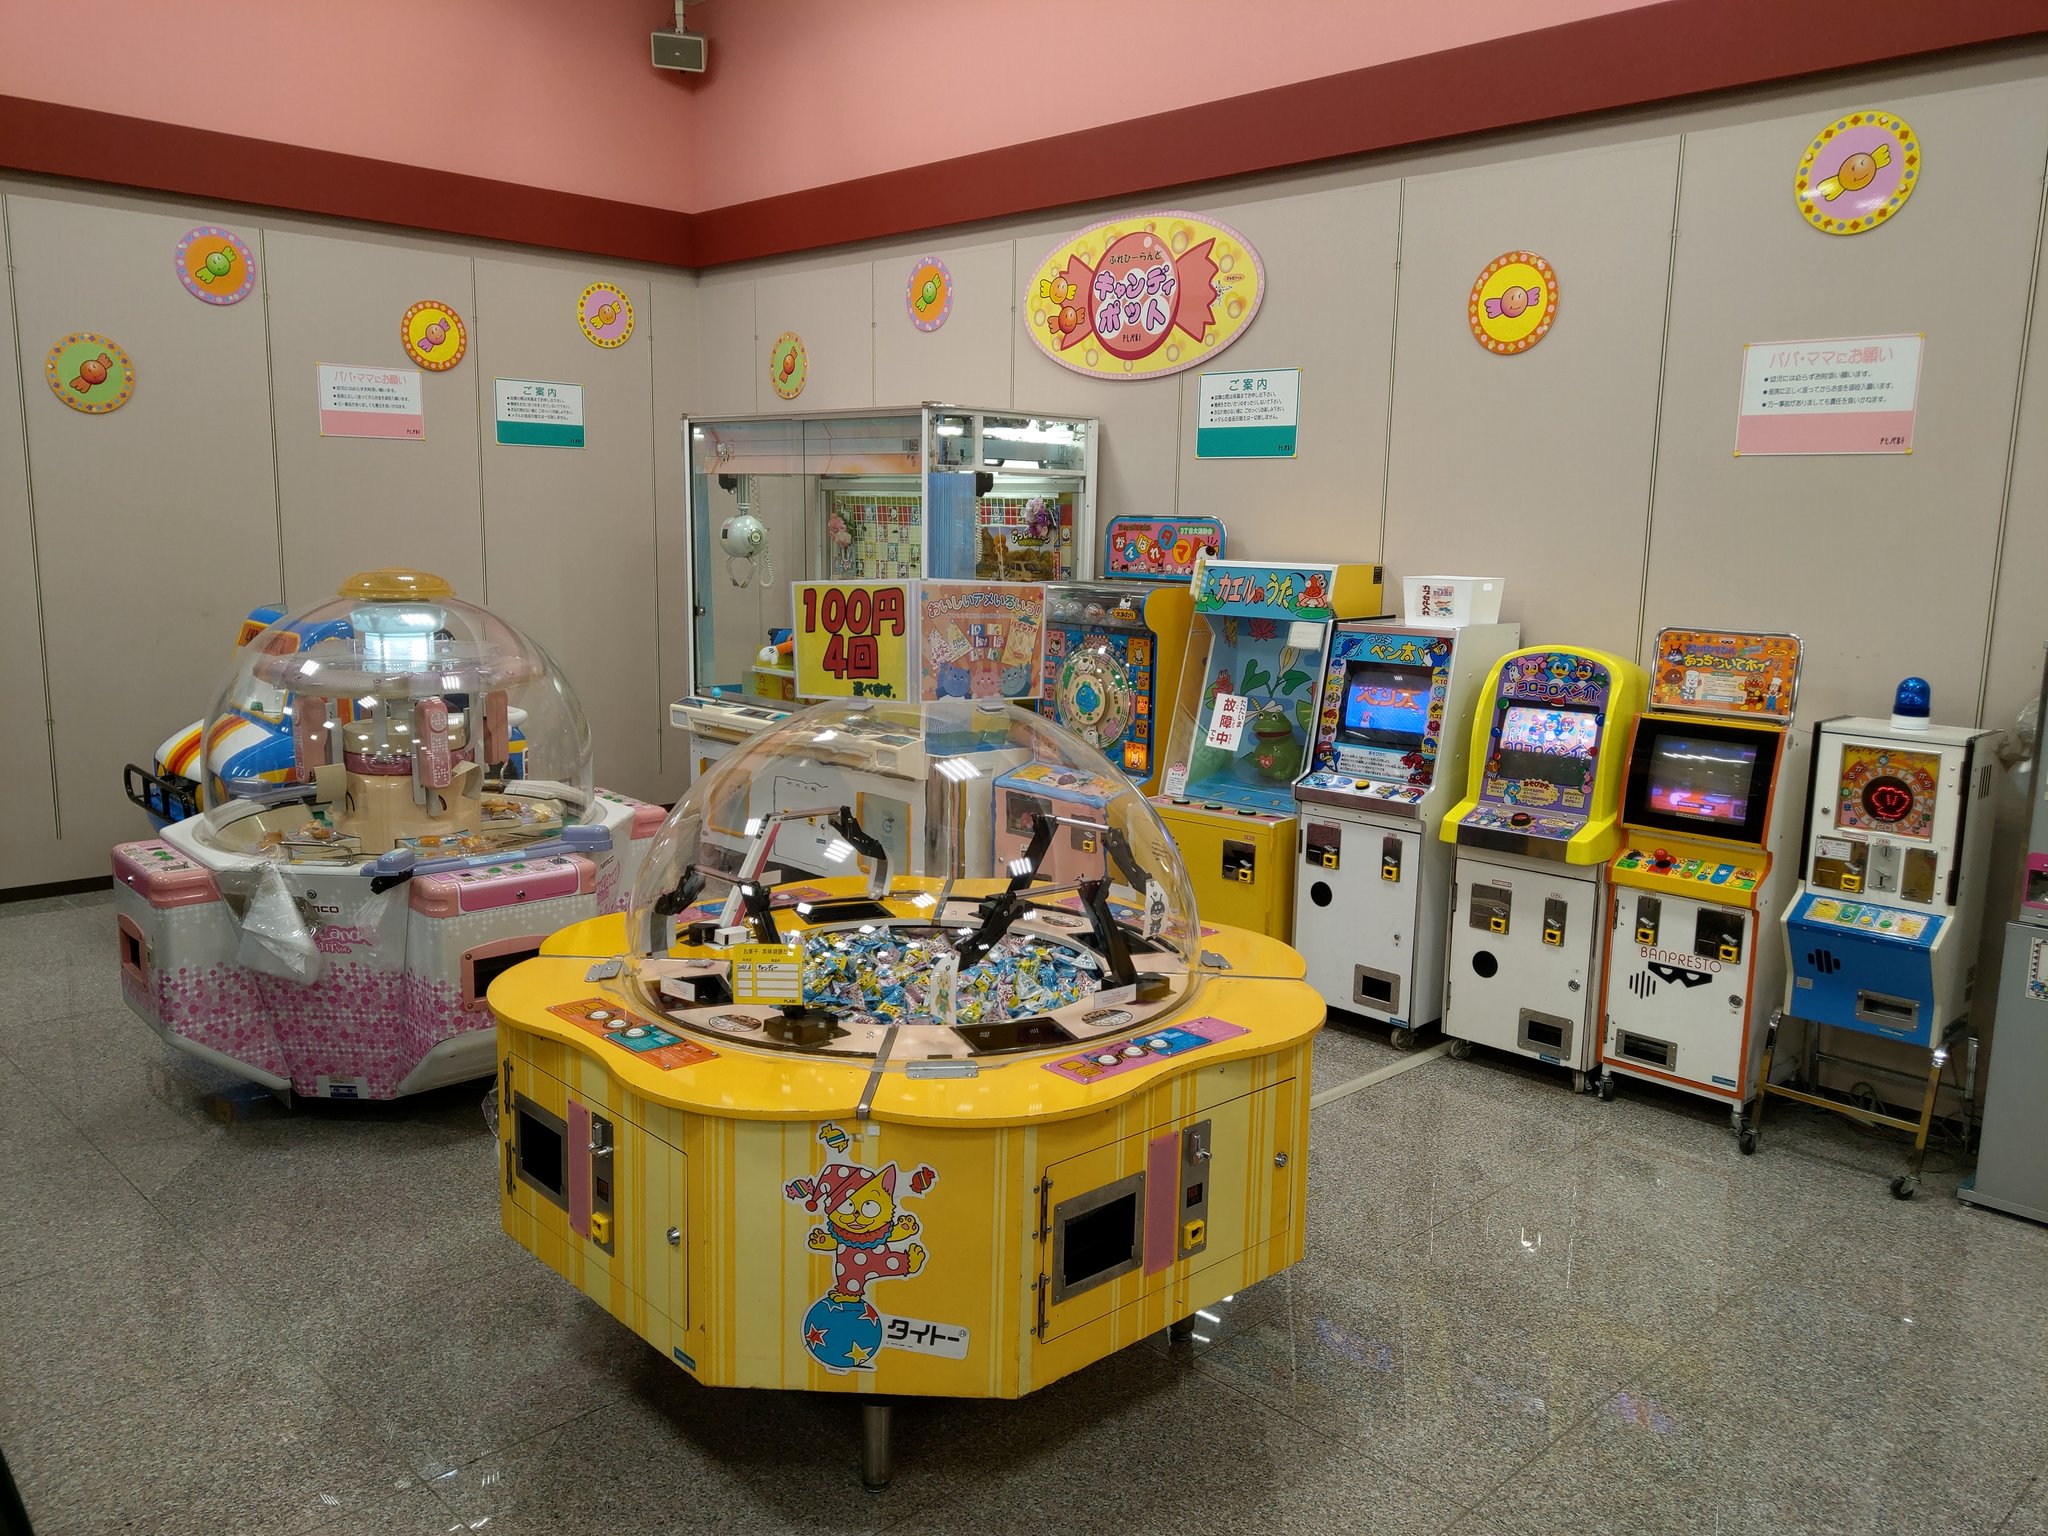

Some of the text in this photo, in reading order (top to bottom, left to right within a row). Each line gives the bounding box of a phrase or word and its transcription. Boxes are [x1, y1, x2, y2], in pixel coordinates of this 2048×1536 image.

[1095, 264, 1176, 301] キャンディ
[1098, 299, 1166, 333] ポット
[1769, 346, 1894, 368] パパ・ママにお願い
[523, 386, 557, 398] ご案内
[1229, 378, 1268, 391] ご案内
[1216, 572, 1295, 609] カエルのうた
[803, 587, 906, 637] 100円
[822, 633, 879, 680] 4回
[1370, 641, 1416, 662] ペン太
[1216, 697, 1237, 745] 故障中
[1640, 946, 1722, 973] BANPRESTO
[887, 1318, 960, 1347] タイトー
